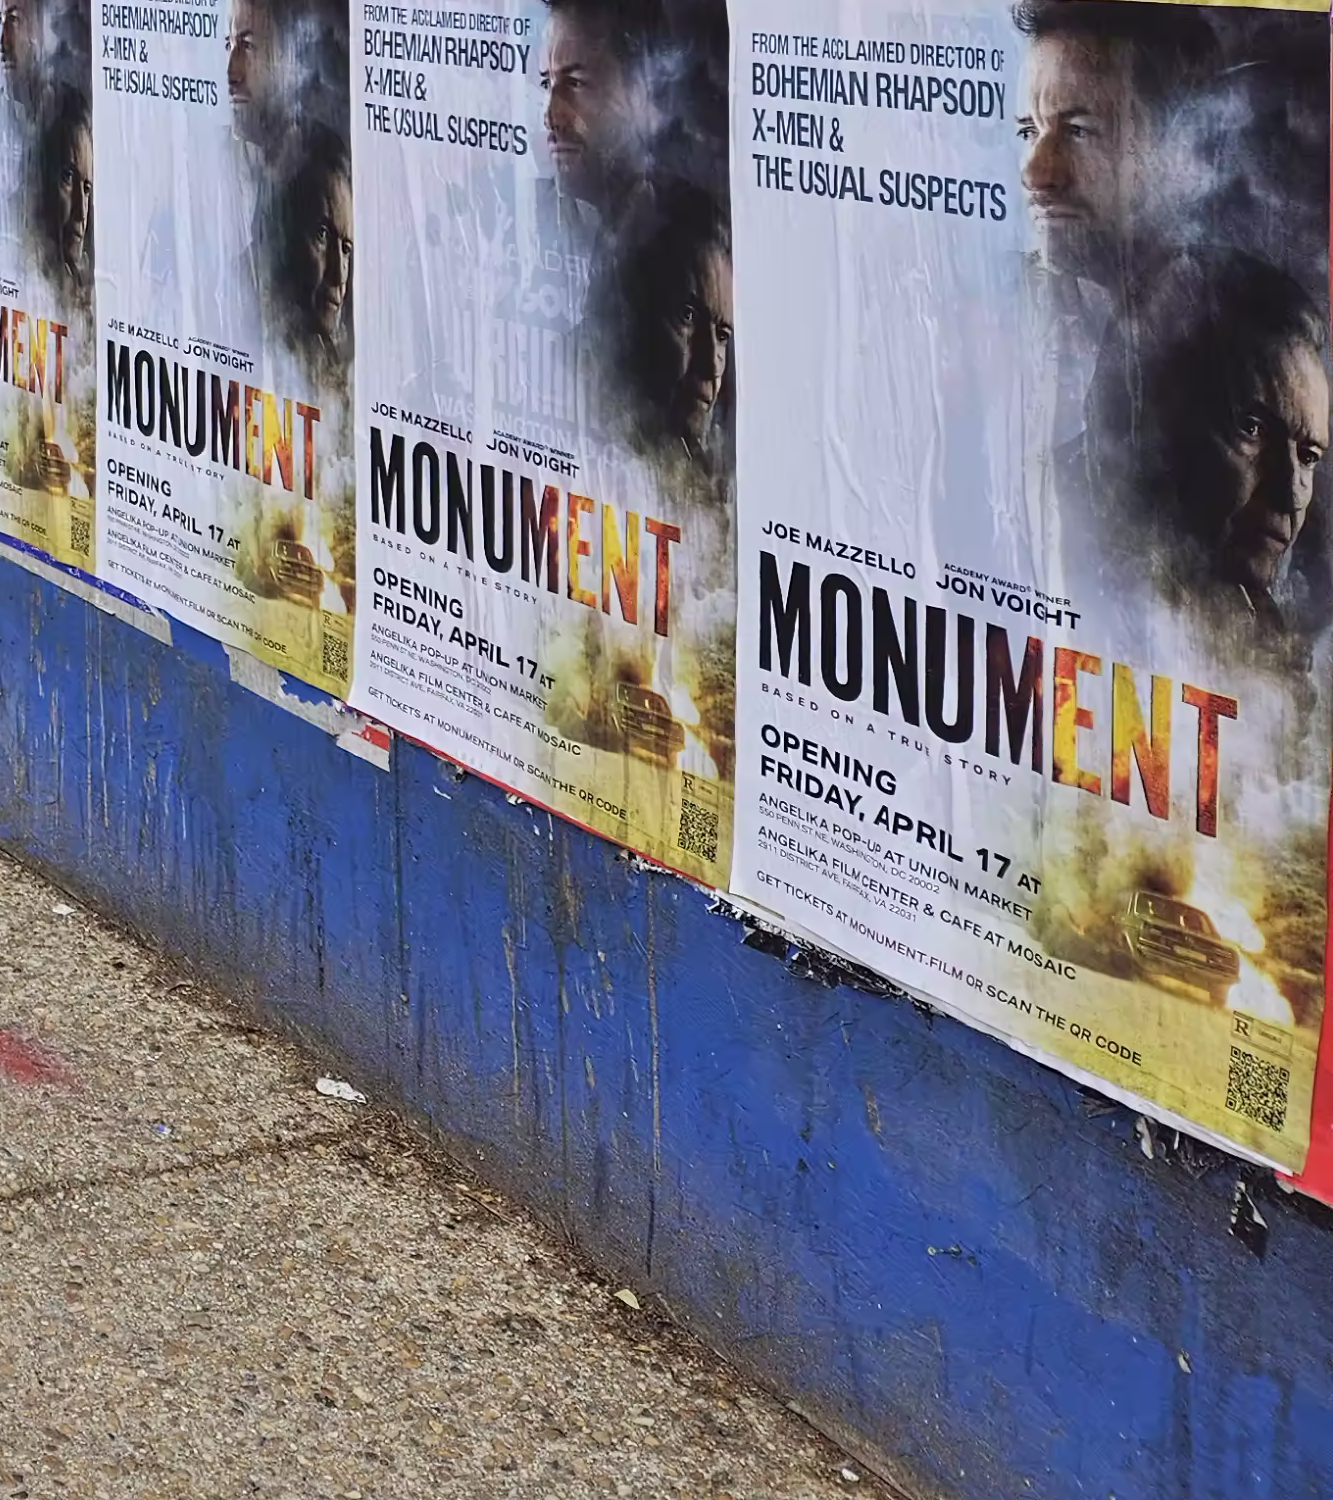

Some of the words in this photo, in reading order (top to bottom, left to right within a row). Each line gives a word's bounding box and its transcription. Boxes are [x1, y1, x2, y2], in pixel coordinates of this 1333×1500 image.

[102, 4, 157, 32] BOHEMIAN
[159, 9, 218, 38] RHAPSODY
[364, 28, 441, 64] BOHEMIAN
[446, 37, 530, 74] RHAPSODY
[752, 33, 789, 55] FROM
[793, 36, 818, 57] THE
[822, 38, 905, 63] ACCLAIMED
[911, 44, 986, 70] DIRECTOR
[365, 103, 391, 133] THE
[394, 107, 444, 142] USUAL
[752, 63, 868, 107] BOHEMIAN
[876, 73, 1005, 120] RHAPSODY
[752, 108, 824, 149] X-MEN
[829, 117, 844, 152] &
[752, 154, 794, 192] THE
[799, 160, 873, 203] USUAL
[879, 169, 1007, 221] SUSPECTS
[107, 339, 321, 500] MONUMENT
[107, 458, 172, 497] OPENING
[370, 426, 680, 637] MONUMENT
[373, 567, 463, 619] OPENING
[762, 520, 800, 545] JOE
[806, 532, 916, 579] MAZZELLO
[935, 574, 985, 602] JON
[992, 590, 1081, 630] VOIGHT
[373, 593, 444, 640] FRIDAY,
[449, 626, 510, 669] APRIL
[759, 550, 1238, 837] MONUMENT
[761, 724, 897, 795] OPENING
[761, 755, 864, 822] FRIDAY,
[874, 805, 963, 863] APRIL
[976, 848, 1011, 879] 17
[1017, 873, 1042, 895] AT
